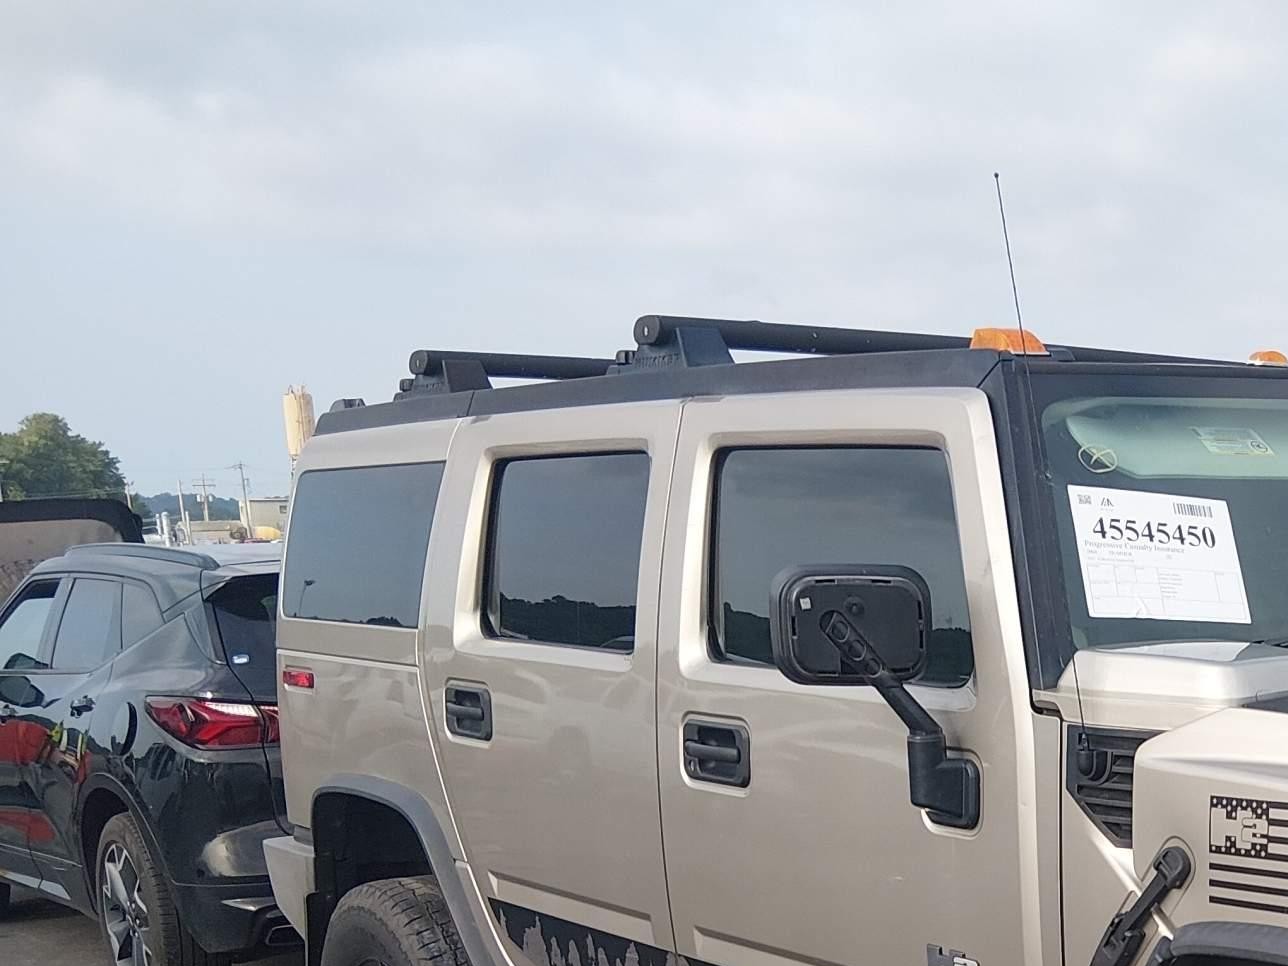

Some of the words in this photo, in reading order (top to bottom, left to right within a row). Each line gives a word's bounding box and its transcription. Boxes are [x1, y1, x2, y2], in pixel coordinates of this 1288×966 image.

[1084, 540, 1125, 551] Progressive
[1093, 517, 1216, 549] 45545450
[1211, 807, 1268, 850] H2
